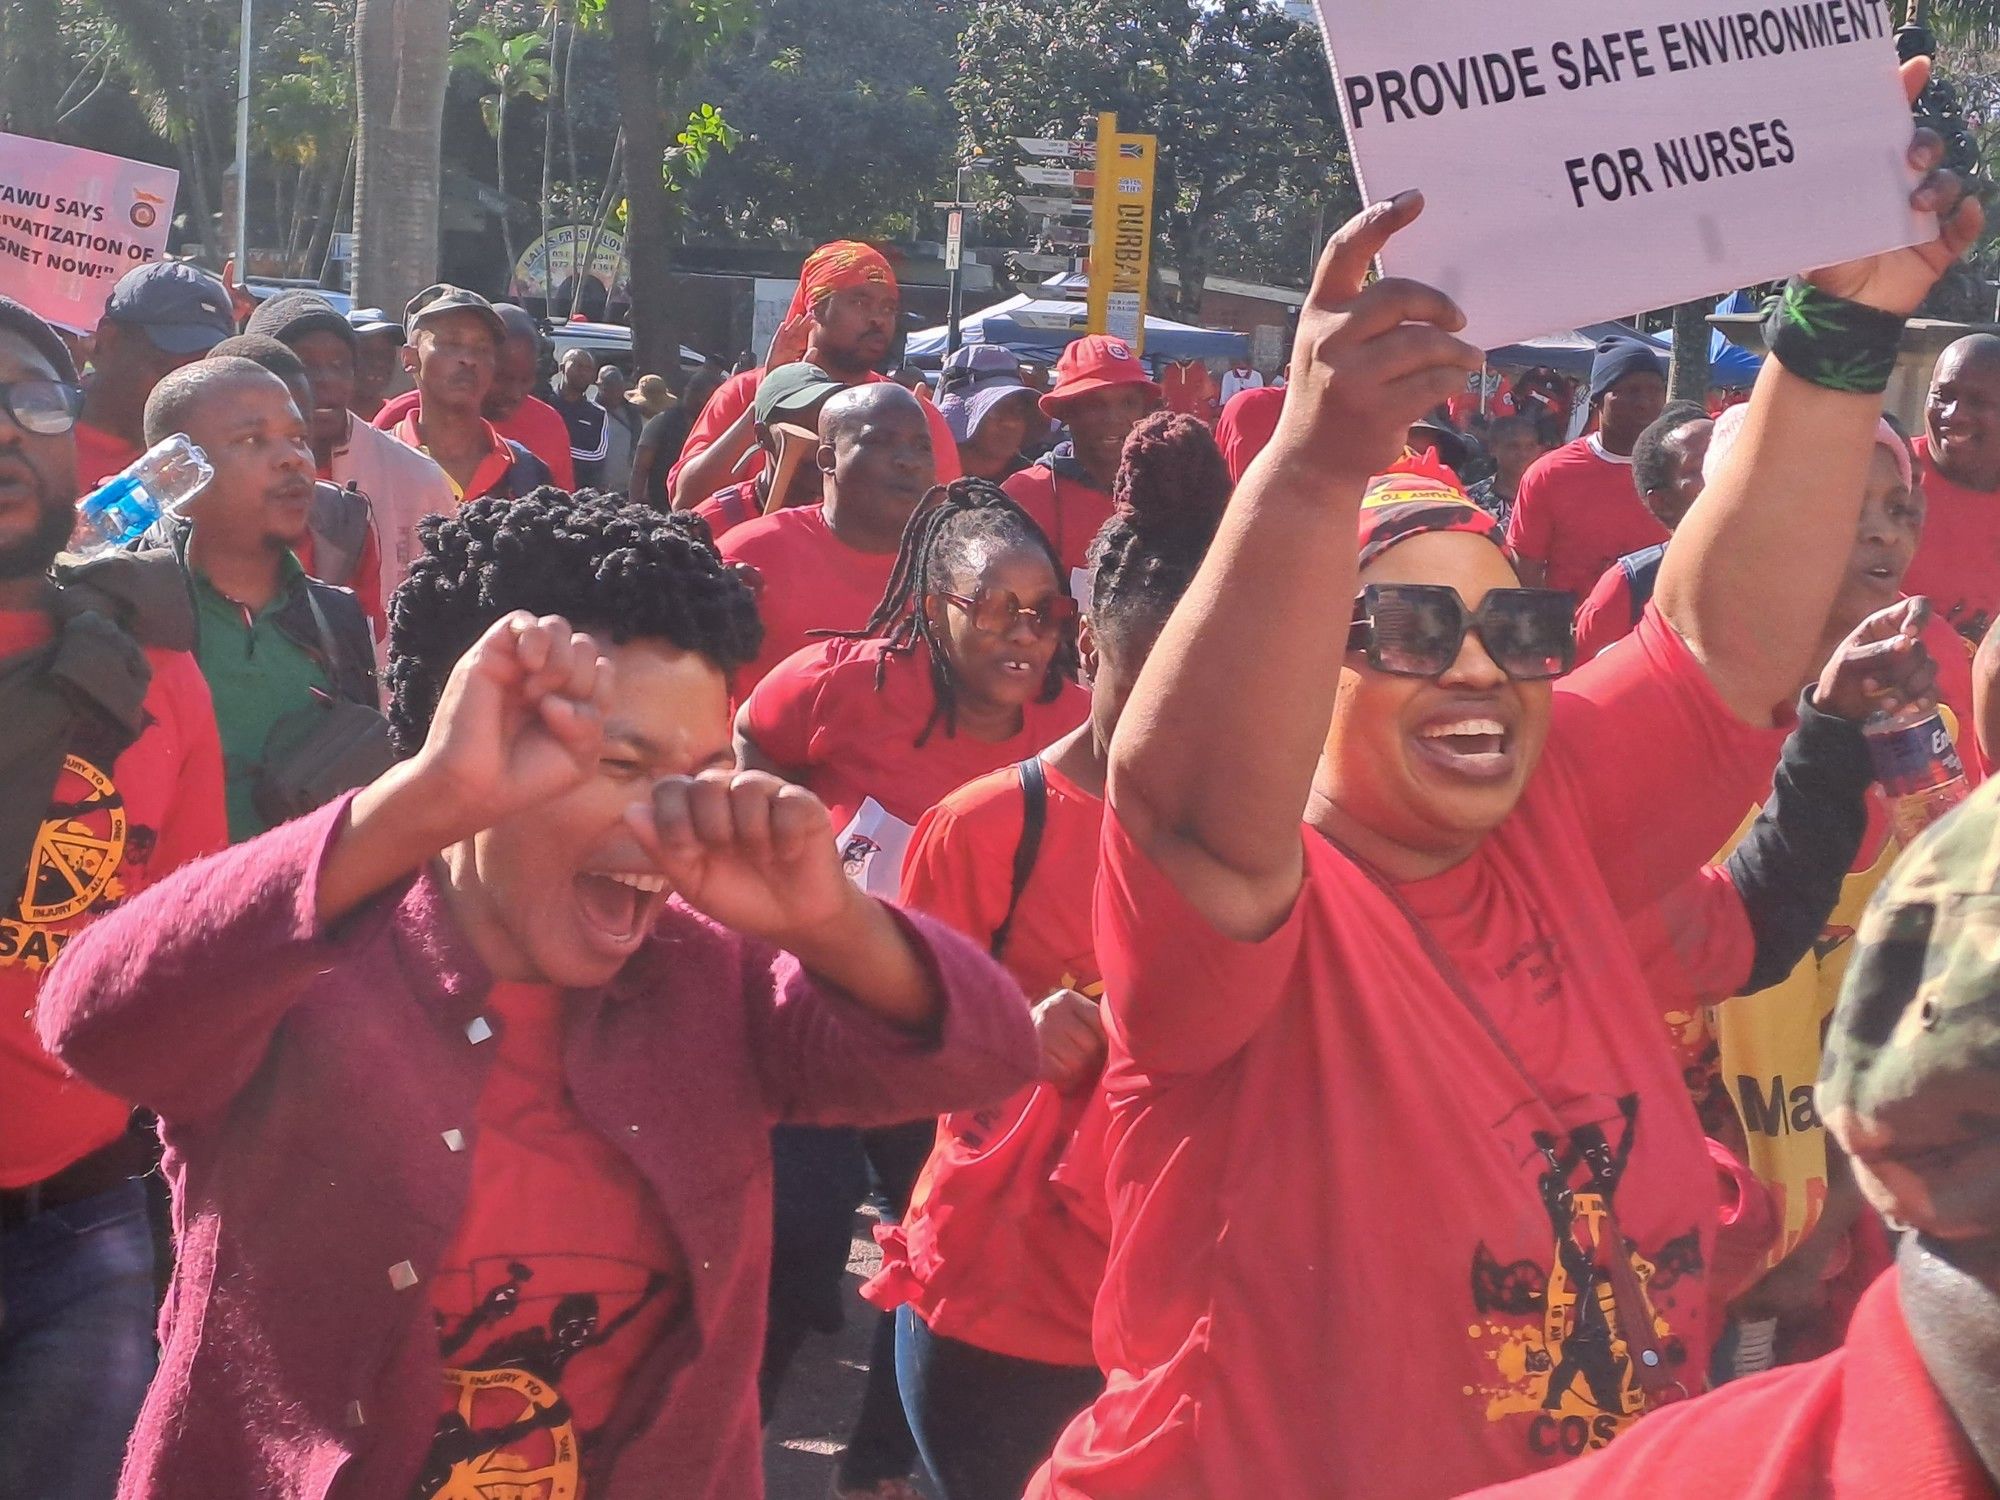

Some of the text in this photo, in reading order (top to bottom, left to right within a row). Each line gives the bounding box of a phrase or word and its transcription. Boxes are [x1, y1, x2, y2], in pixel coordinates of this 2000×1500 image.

[1345, 0, 1884, 129] PROVIDE SAFE ENVIRONMENT
[1564, 118, 1796, 208] FOR NURSES
[54, 197, 105, 222] SAYS
[127, 244, 155, 263] OF
[1112, 204, 1145, 293] DURBAN
